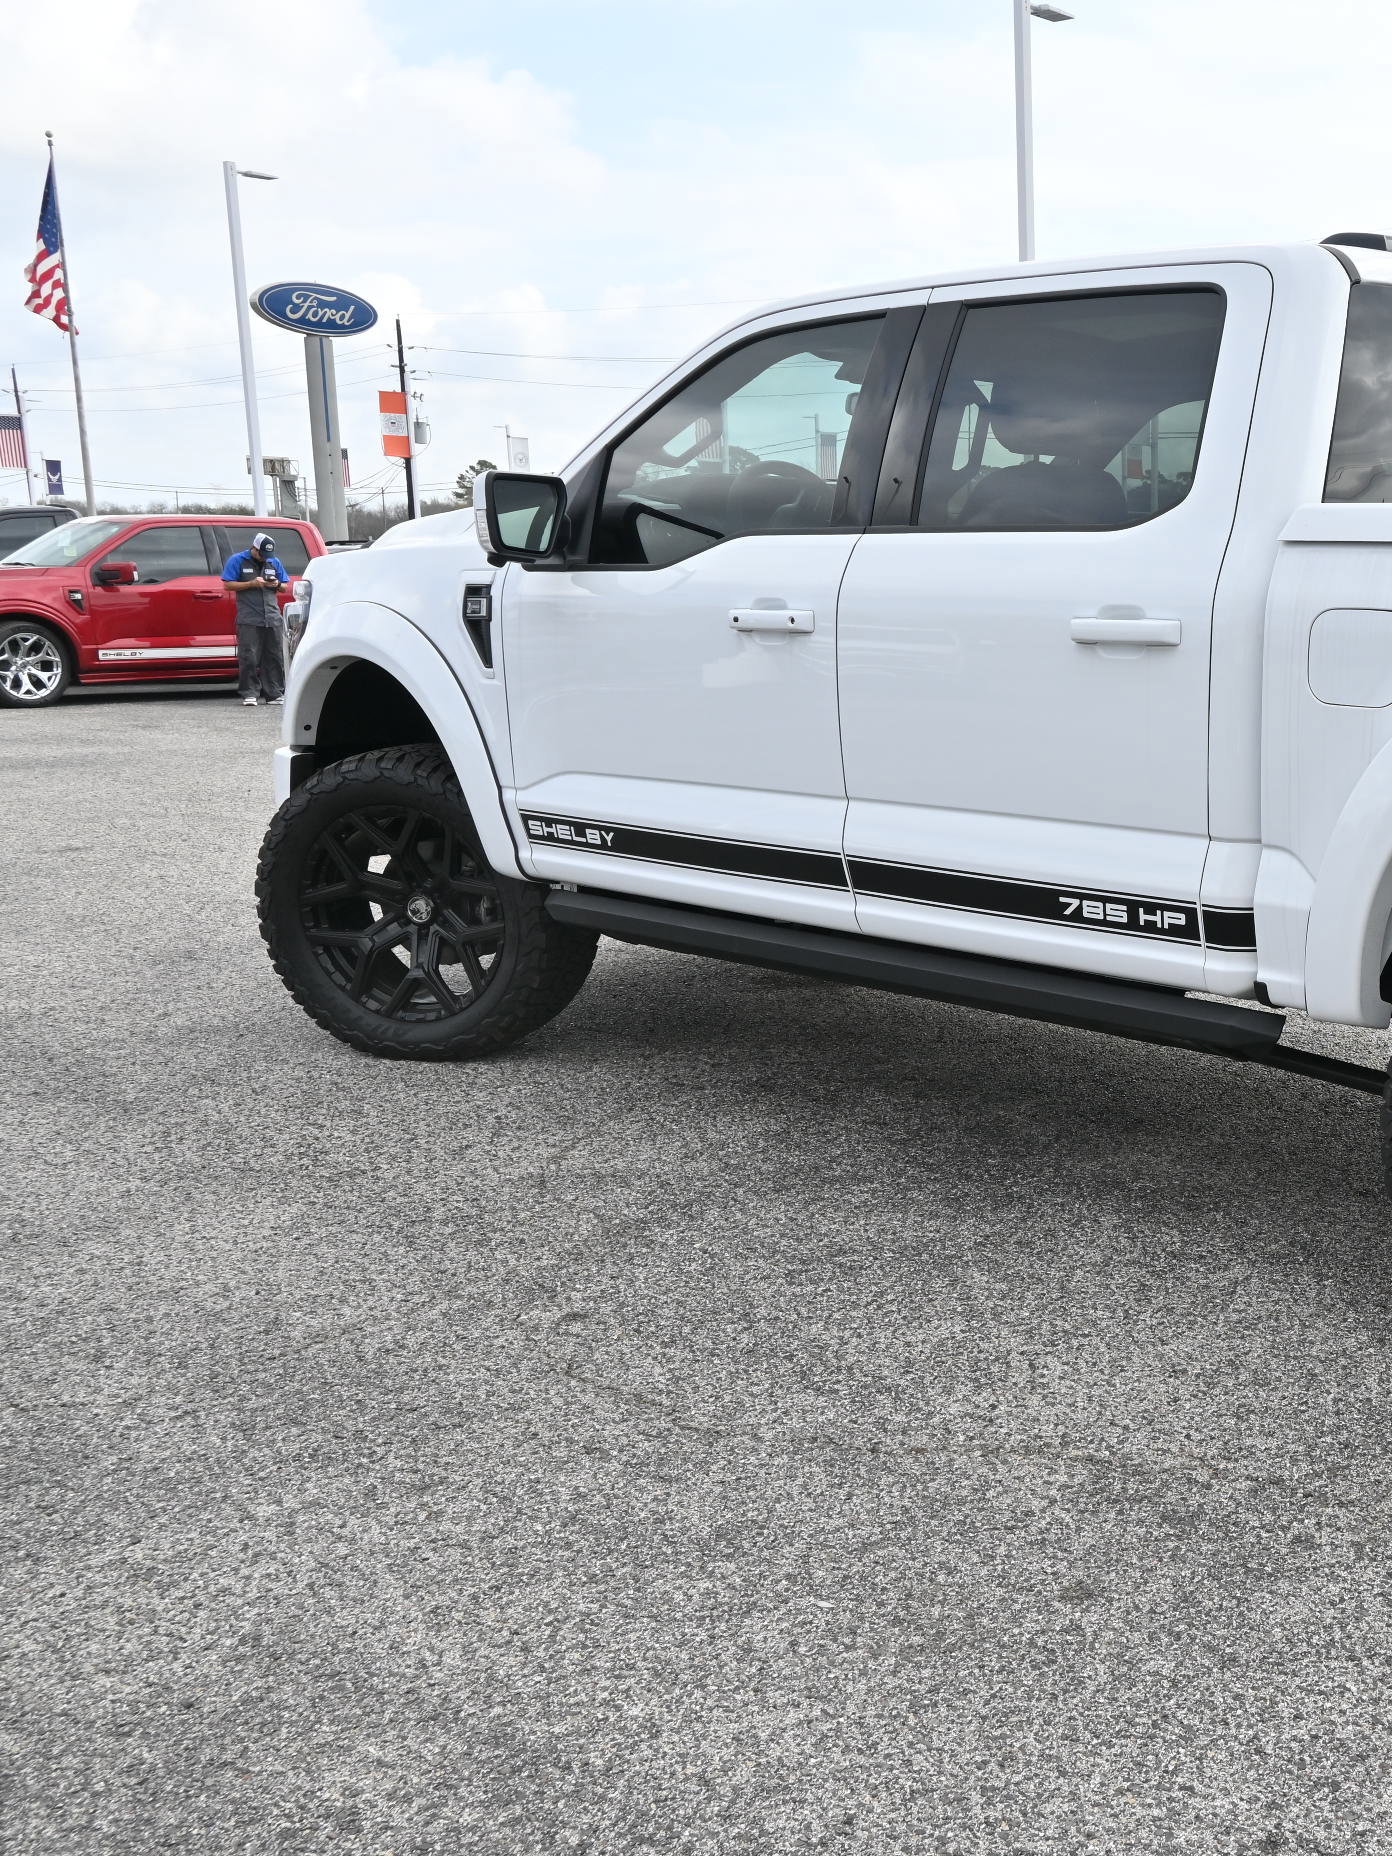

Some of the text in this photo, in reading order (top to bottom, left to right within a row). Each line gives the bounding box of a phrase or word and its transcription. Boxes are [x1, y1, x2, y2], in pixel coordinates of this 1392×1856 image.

[286, 291, 355, 325] Ford
[528, 820, 614, 847] SHELBY
[1059, 897, 1186, 930] 785 HP
